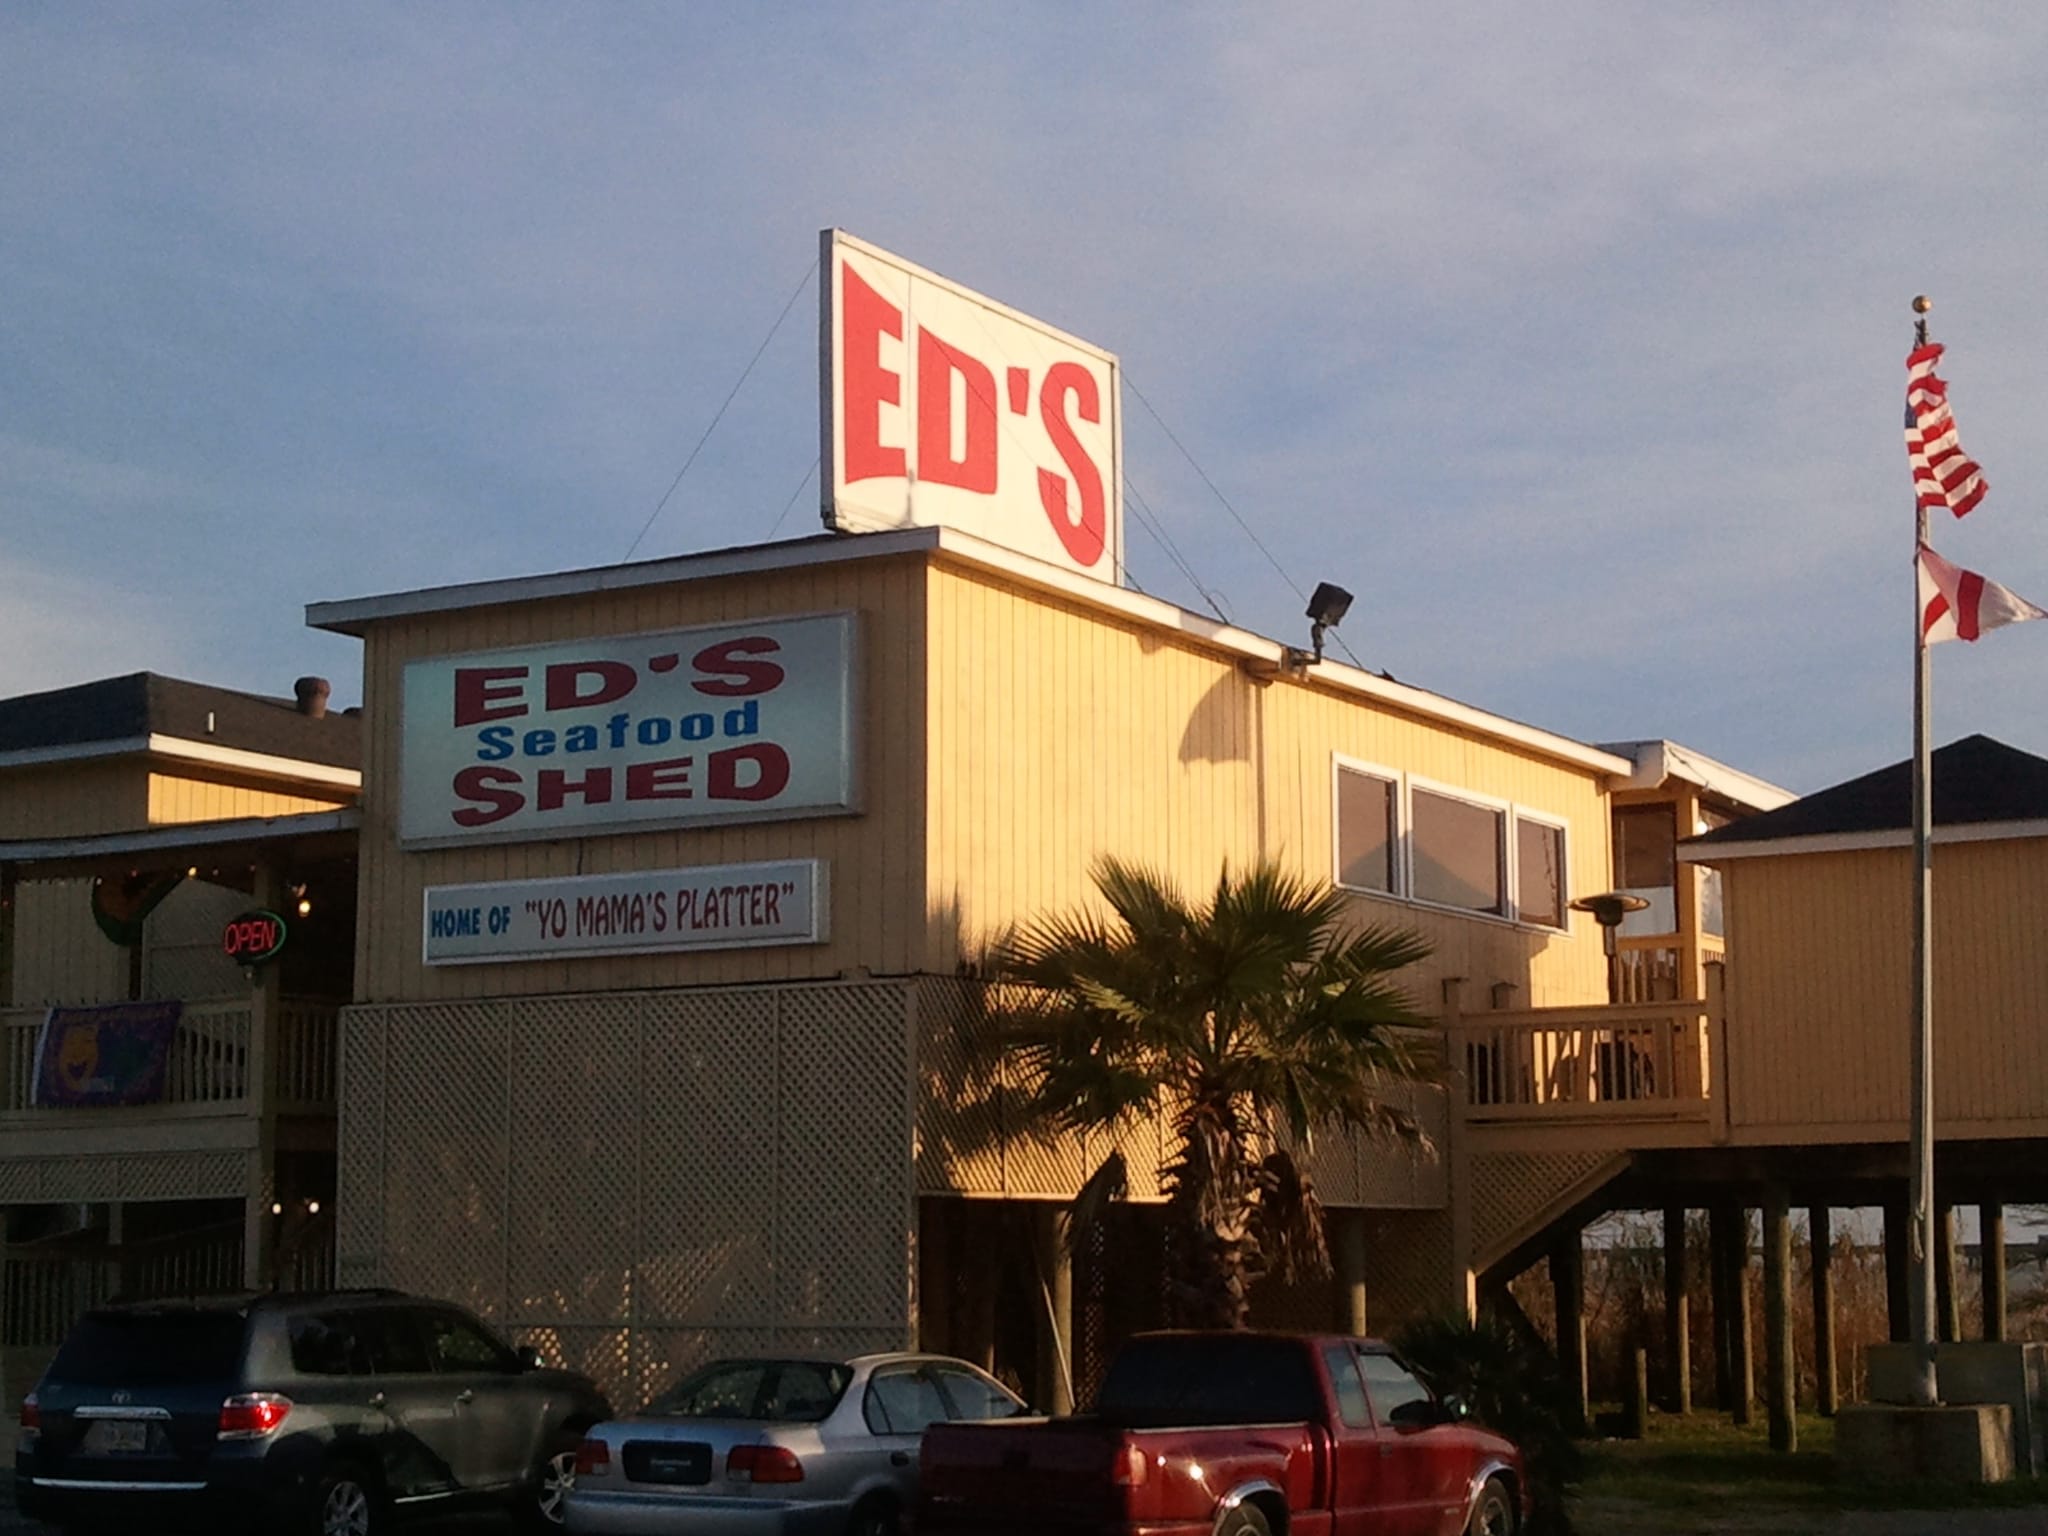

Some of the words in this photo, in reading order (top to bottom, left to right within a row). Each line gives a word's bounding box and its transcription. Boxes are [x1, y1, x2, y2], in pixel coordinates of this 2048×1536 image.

[842, 259, 1105, 567] ED'S
[455, 636, 785, 728] ED'S
[477, 700, 759, 760] Seafood
[451, 742, 790, 827] SHED
[224, 920, 276, 954] OPEN
[431, 908, 481, 938] HOME
[488, 906, 511, 934] OF
[526, 898, 568, 940] "YO
[576, 891, 667, 936] MAMA'S
[676, 882, 794, 931] PLATTER"
